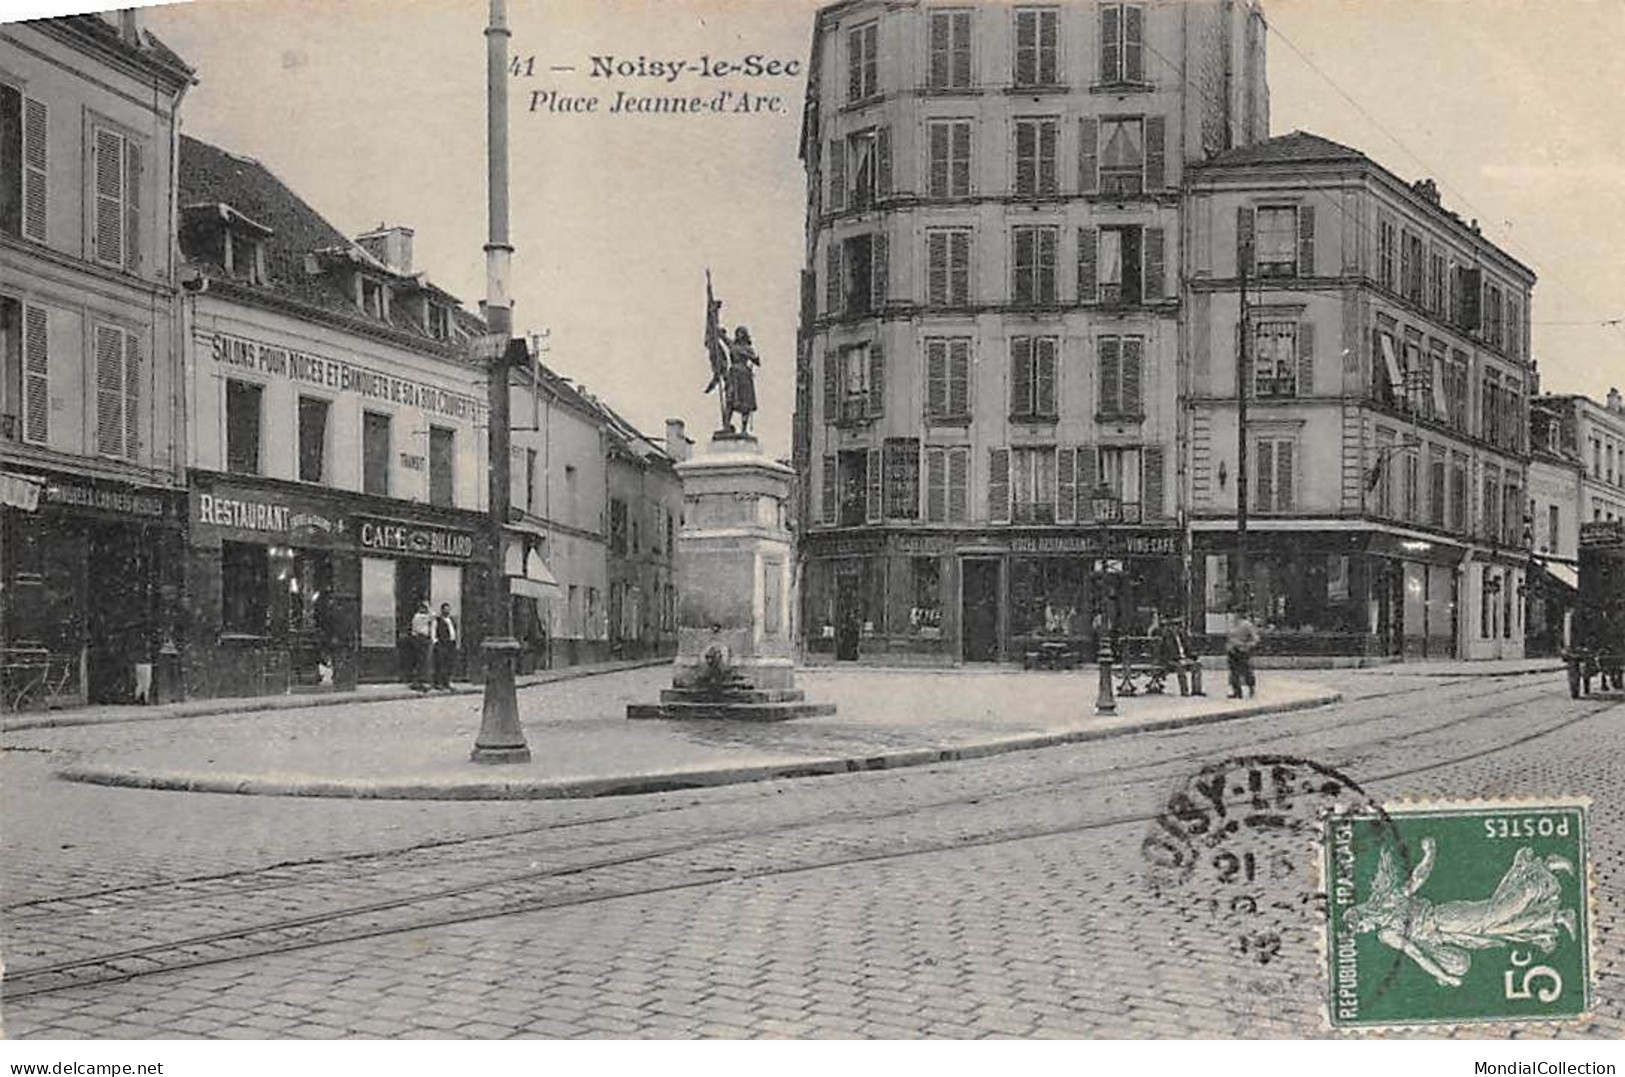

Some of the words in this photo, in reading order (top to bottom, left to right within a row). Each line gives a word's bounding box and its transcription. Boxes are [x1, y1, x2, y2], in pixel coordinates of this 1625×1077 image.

[259, 346, 287, 375] POUR
[289, 352, 324, 382] NOCES
[326, 362, 340, 386] ET
[340, 365, 389, 400] BANQUETS
[200, 494, 290, 532] RESTAURANT
[431, 532, 472, 558] BILLARD
[1484, 817, 1570, 839] POSTES
